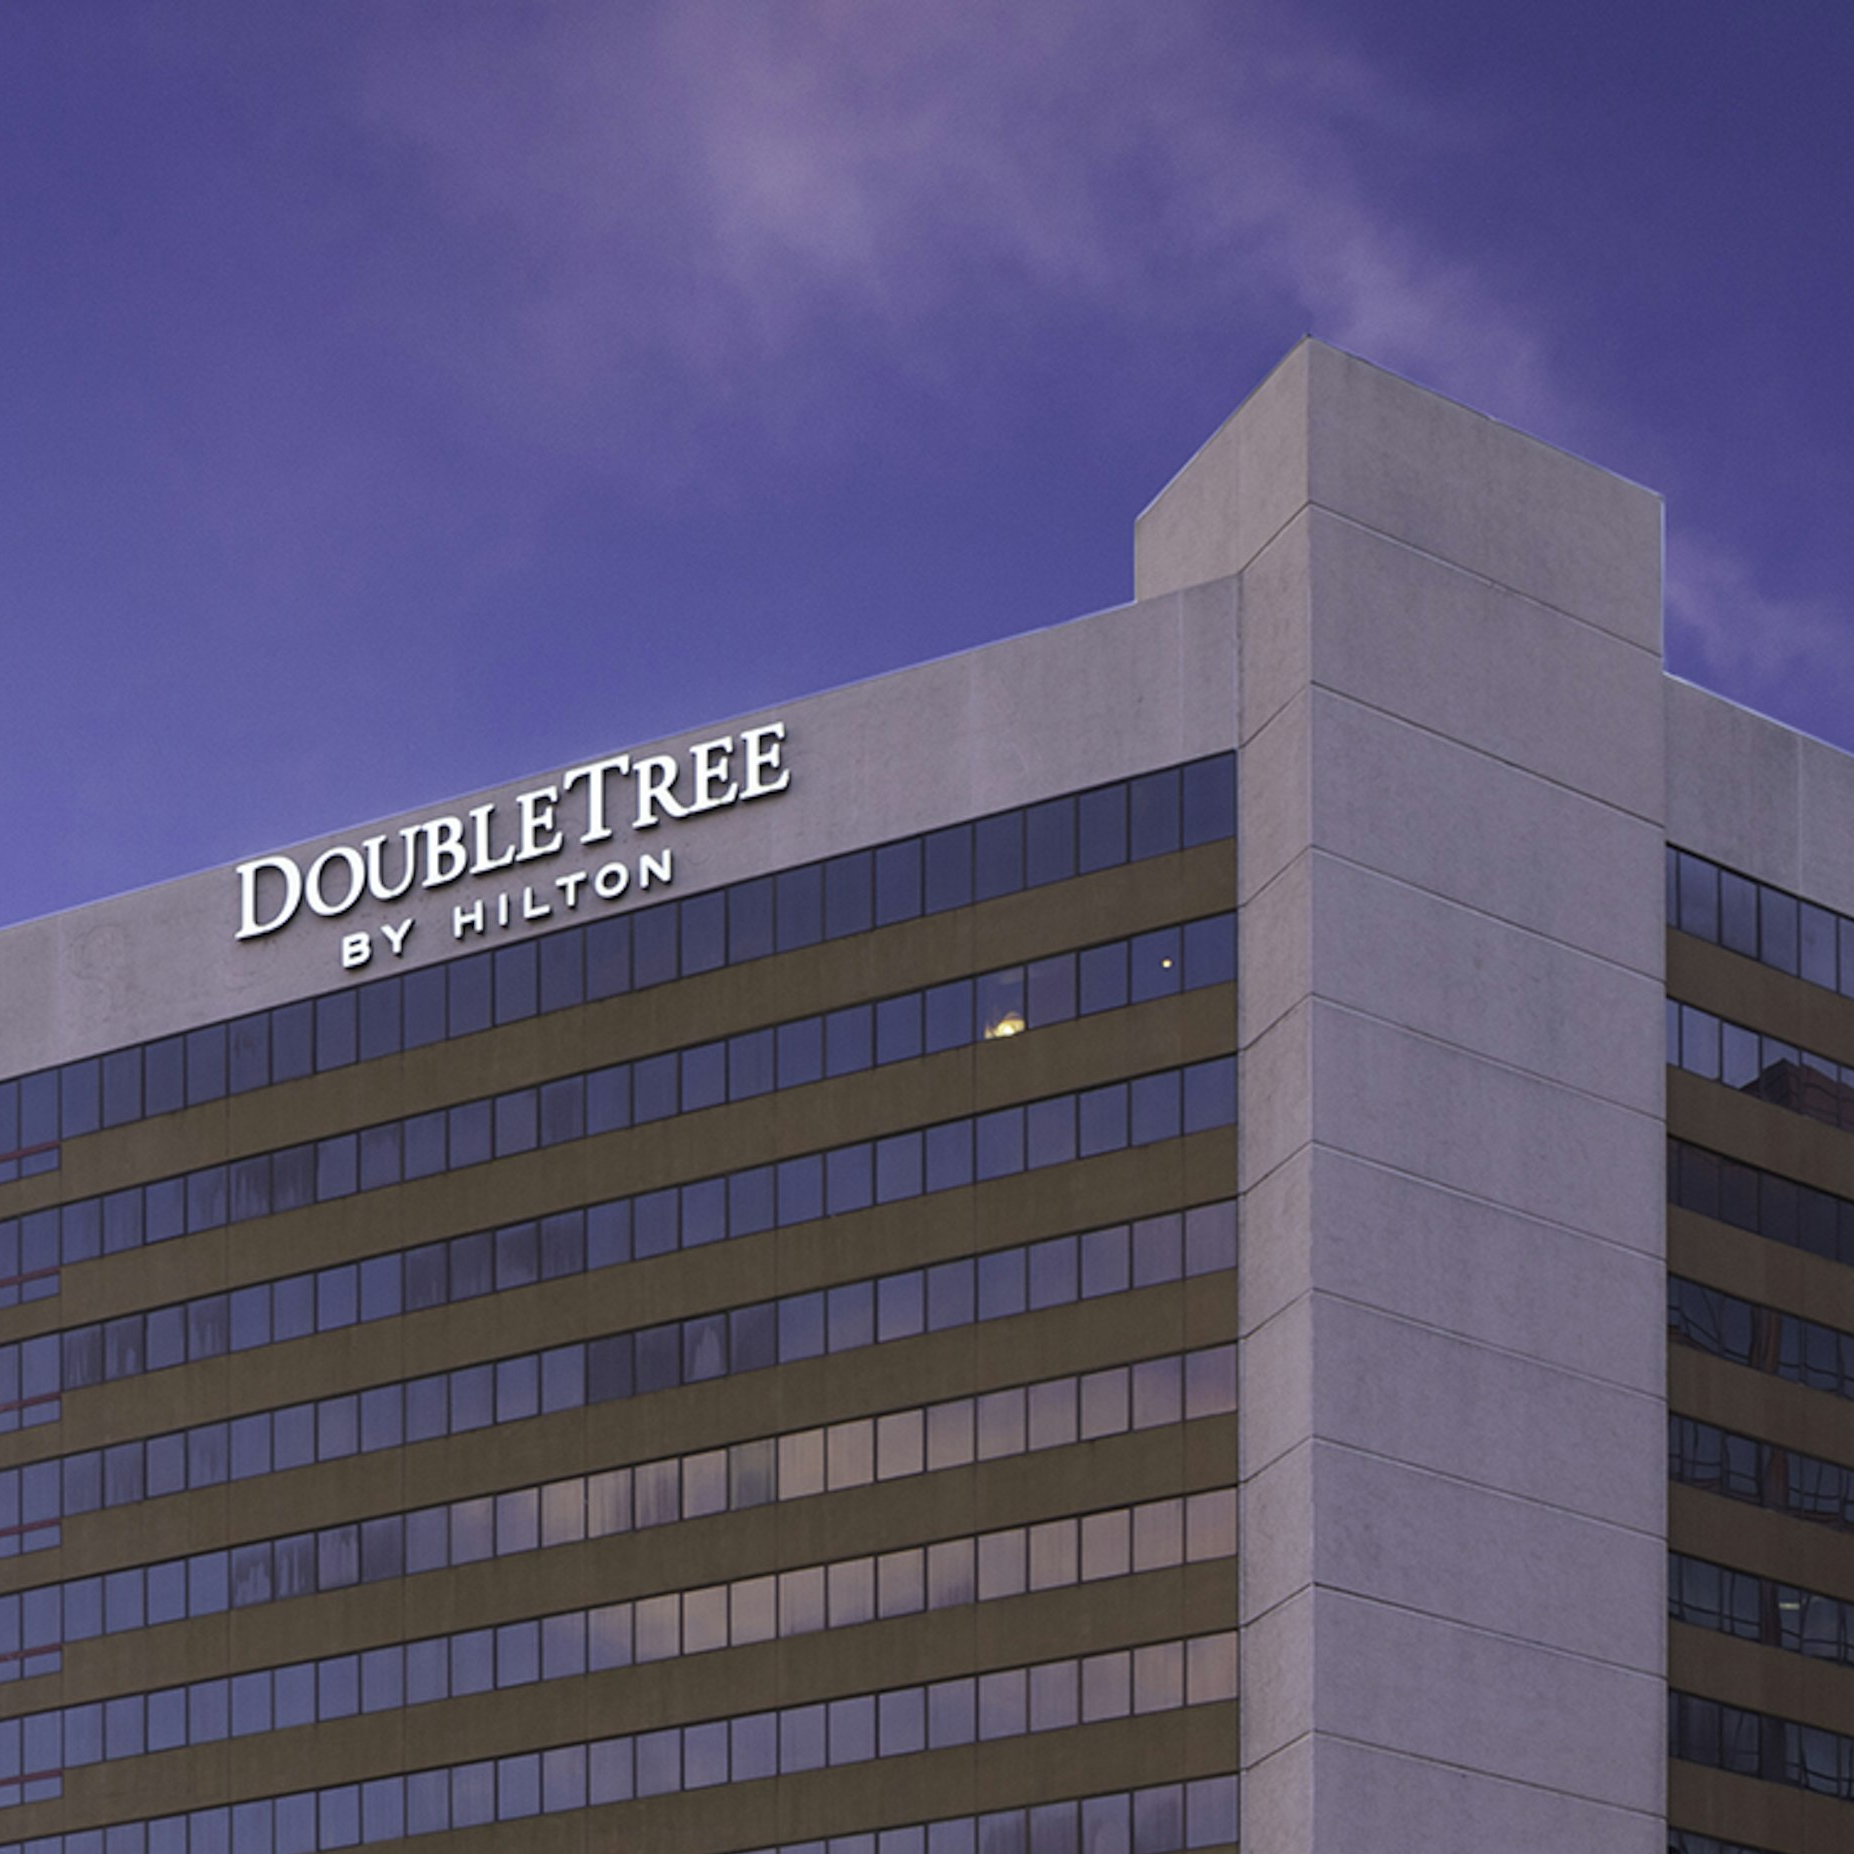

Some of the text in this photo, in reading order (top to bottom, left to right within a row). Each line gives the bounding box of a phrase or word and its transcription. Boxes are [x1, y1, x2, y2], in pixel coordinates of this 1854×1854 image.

[235, 721, 791, 940] DOUBLETREE
[341, 849, 673, 968] BY HILTON
